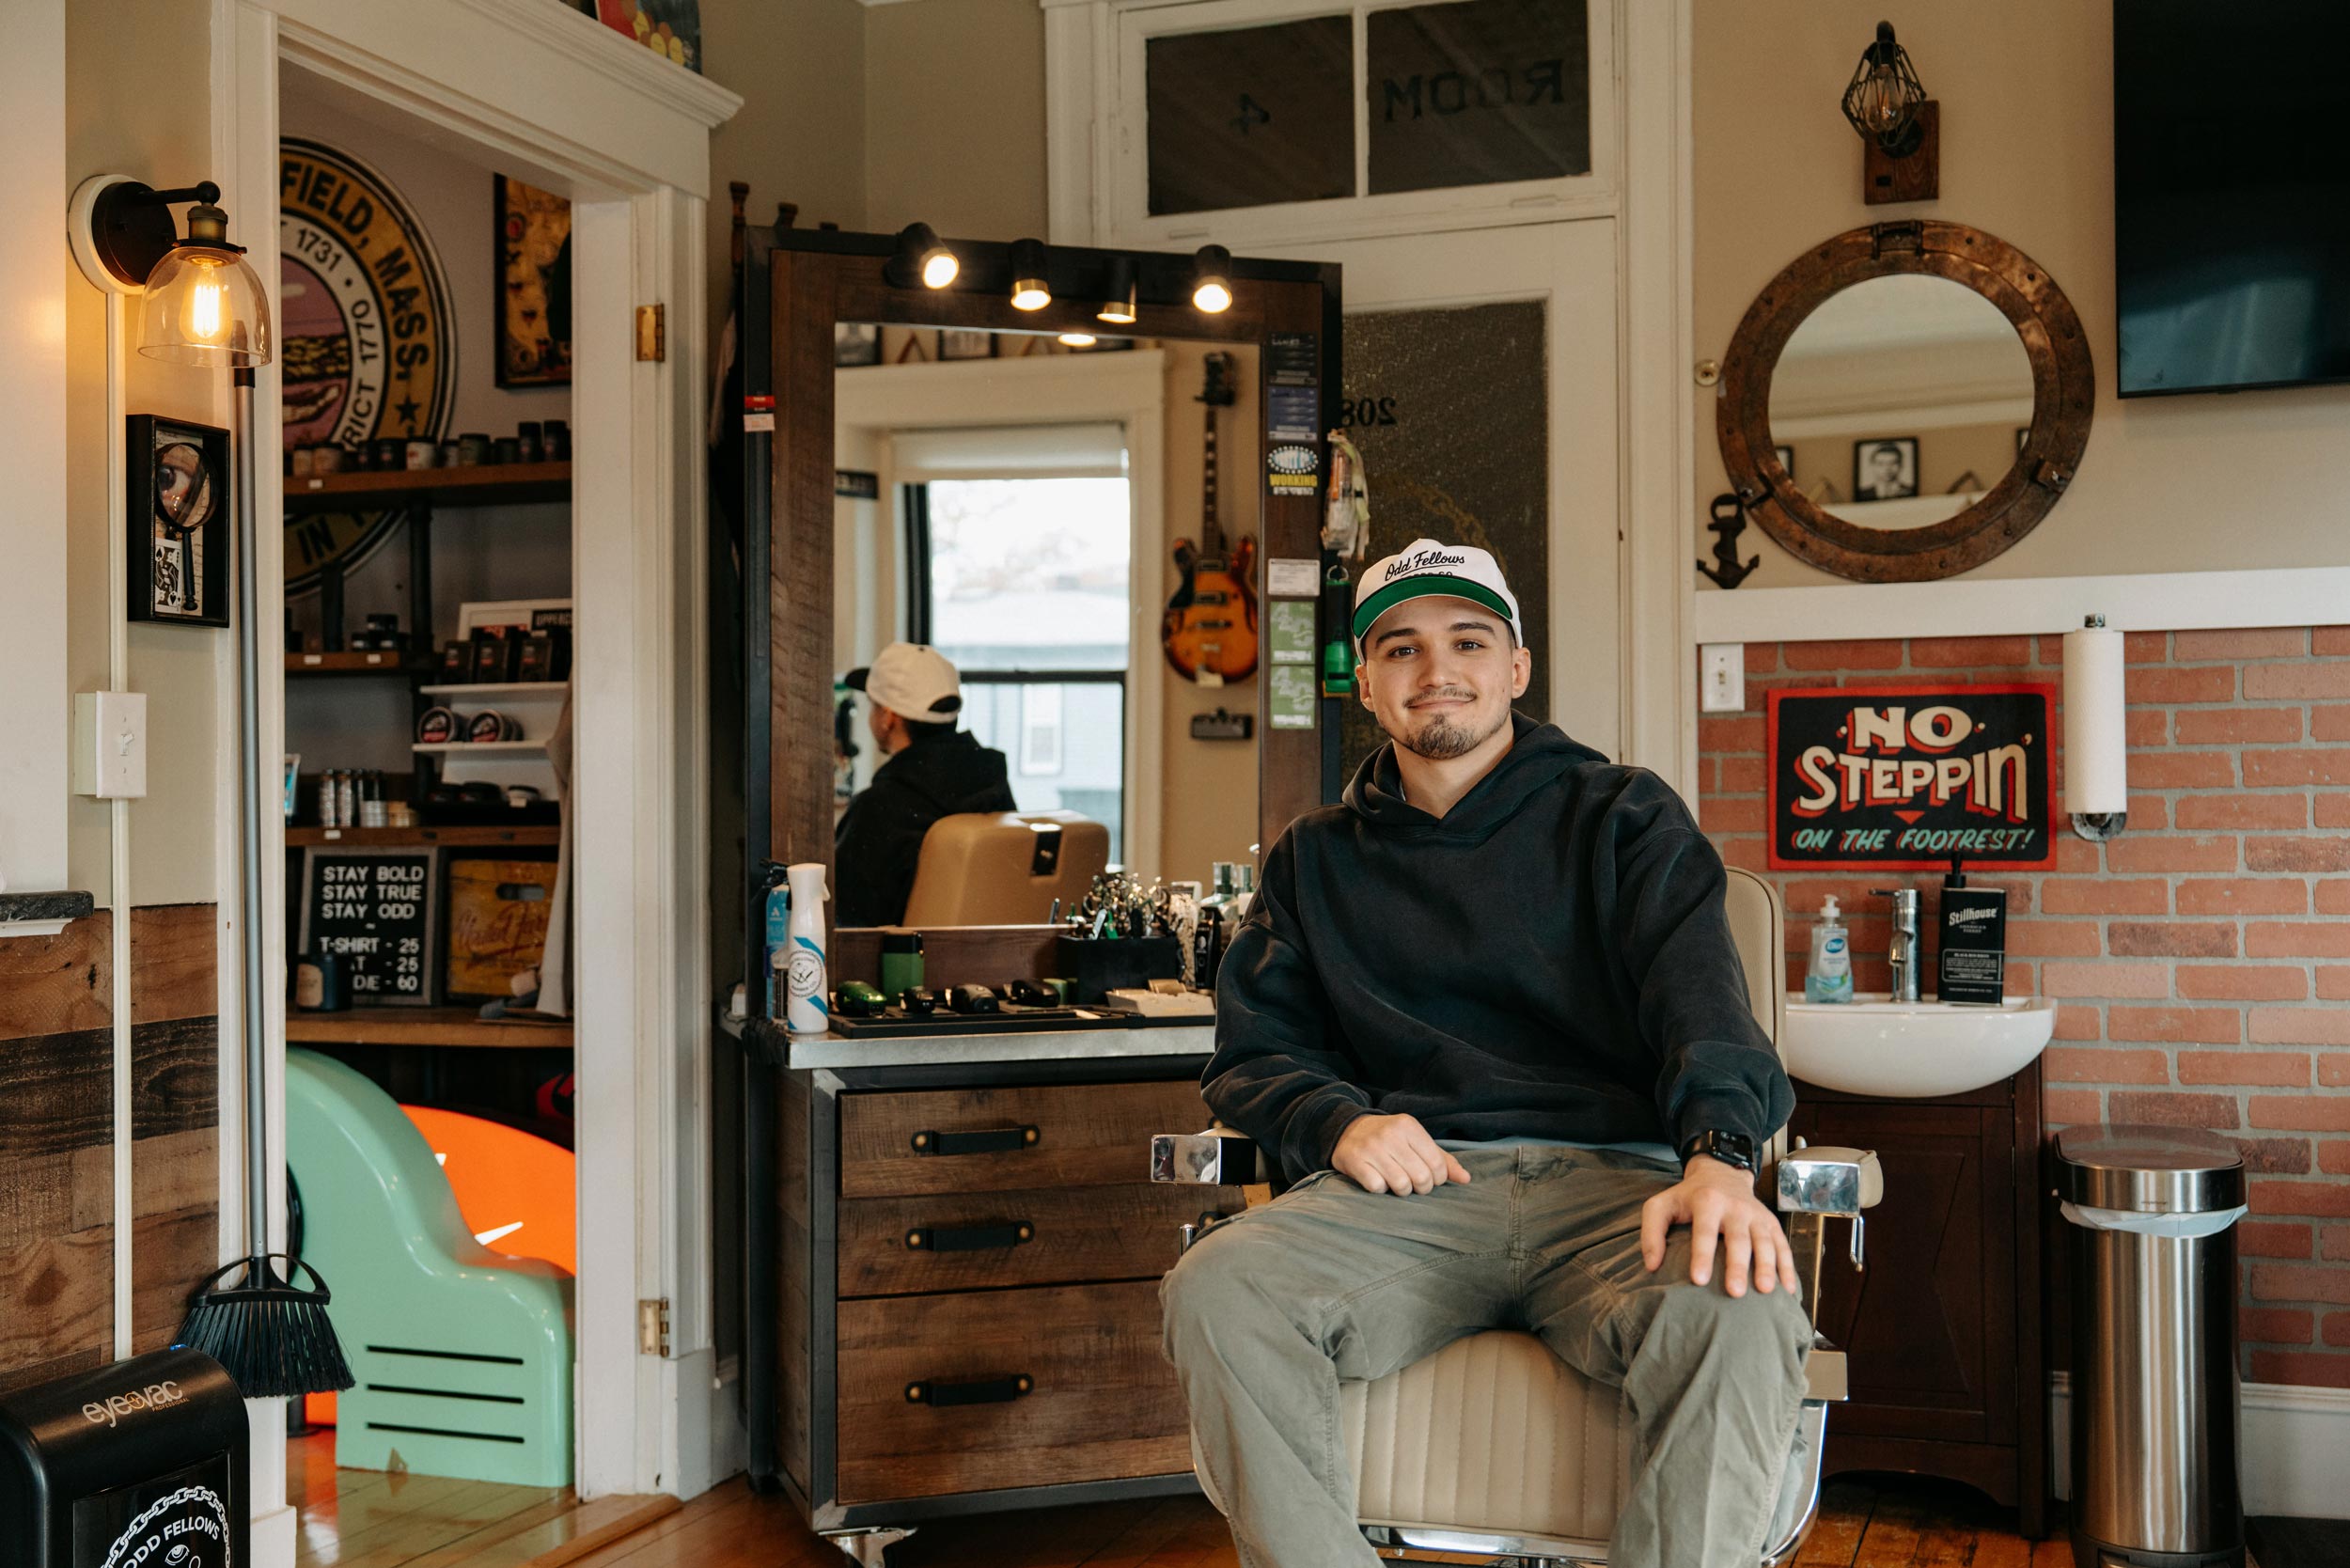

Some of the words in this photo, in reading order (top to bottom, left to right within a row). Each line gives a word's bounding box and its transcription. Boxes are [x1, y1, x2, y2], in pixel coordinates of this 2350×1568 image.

[281, 160, 374, 250] FIELD,
[296, 227, 343, 273] 1731
[350, 299, 380, 364] 1770
[340, 378, 377, 447] RICT
[1384, 557, 1412, 582] Odd
[1413, 550, 1466, 570] Fellows
[1850, 706, 1973, 751] NO
[1794, 828, 1833, 851] ON
[1842, 828, 1892, 851] THE
[1899, 828, 2036, 851] FOOTREST!
[322, 865, 369, 882] STAY
[376, 865, 424, 882] BOLD
[321, 885, 368, 901] STAY
[376, 885, 423, 901] TRUE
[321, 902, 368, 919] STAY
[378, 902, 415, 919] ODD
[1949, 907, 1998, 926] Stillhouse
[320, 936, 380, 954] T-SHIRT
[399, 937, 420, 954] 25
[397, 956, 419, 973] 25
[397, 974, 418, 992] 60
[163, 1515, 221, 1541] FELLOWS
